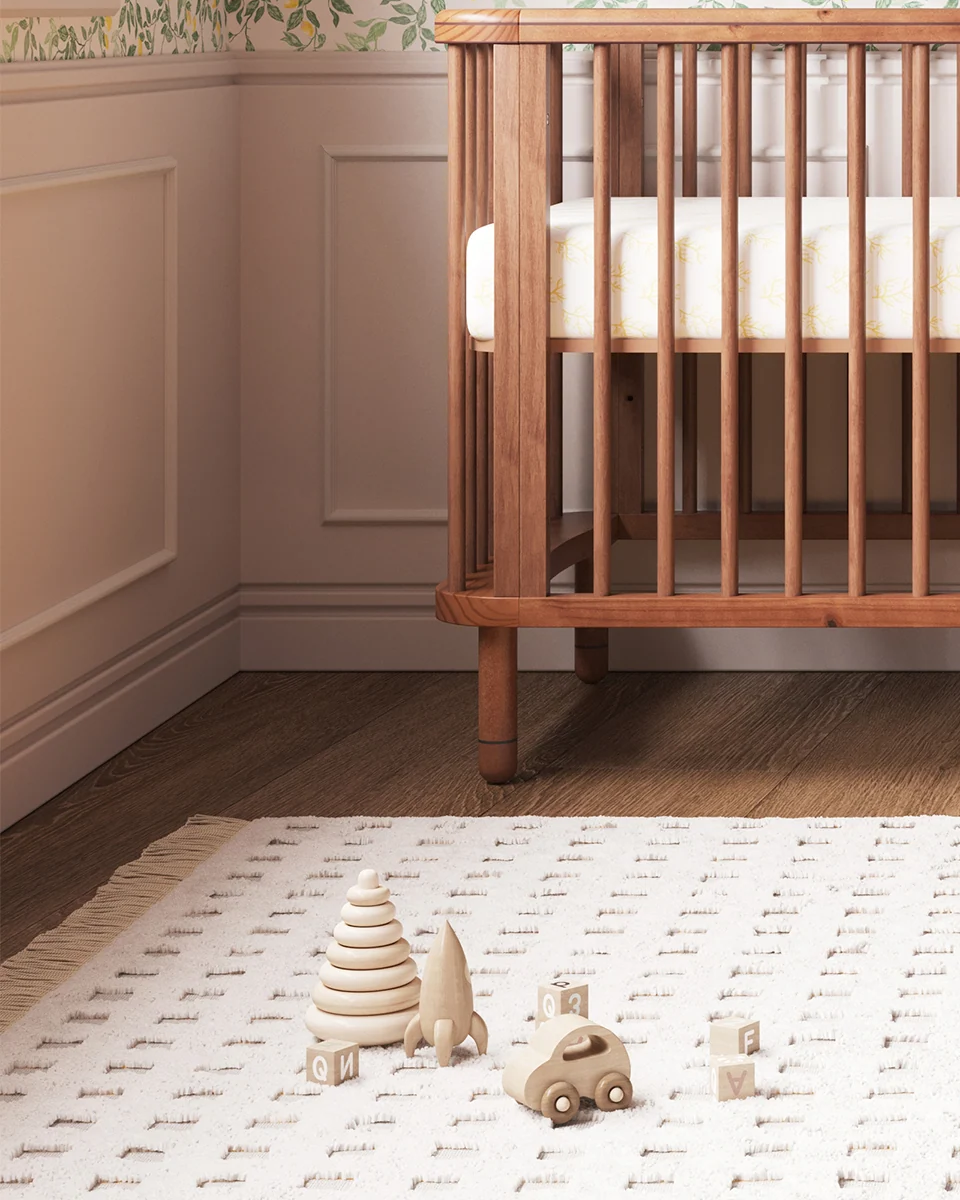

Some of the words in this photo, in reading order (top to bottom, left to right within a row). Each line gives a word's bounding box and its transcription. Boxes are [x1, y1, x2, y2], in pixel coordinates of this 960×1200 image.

[744, 1029, 755, 1055] F
[312, 1055, 328, 1082] Q
[726, 1070, 748, 1096] A
